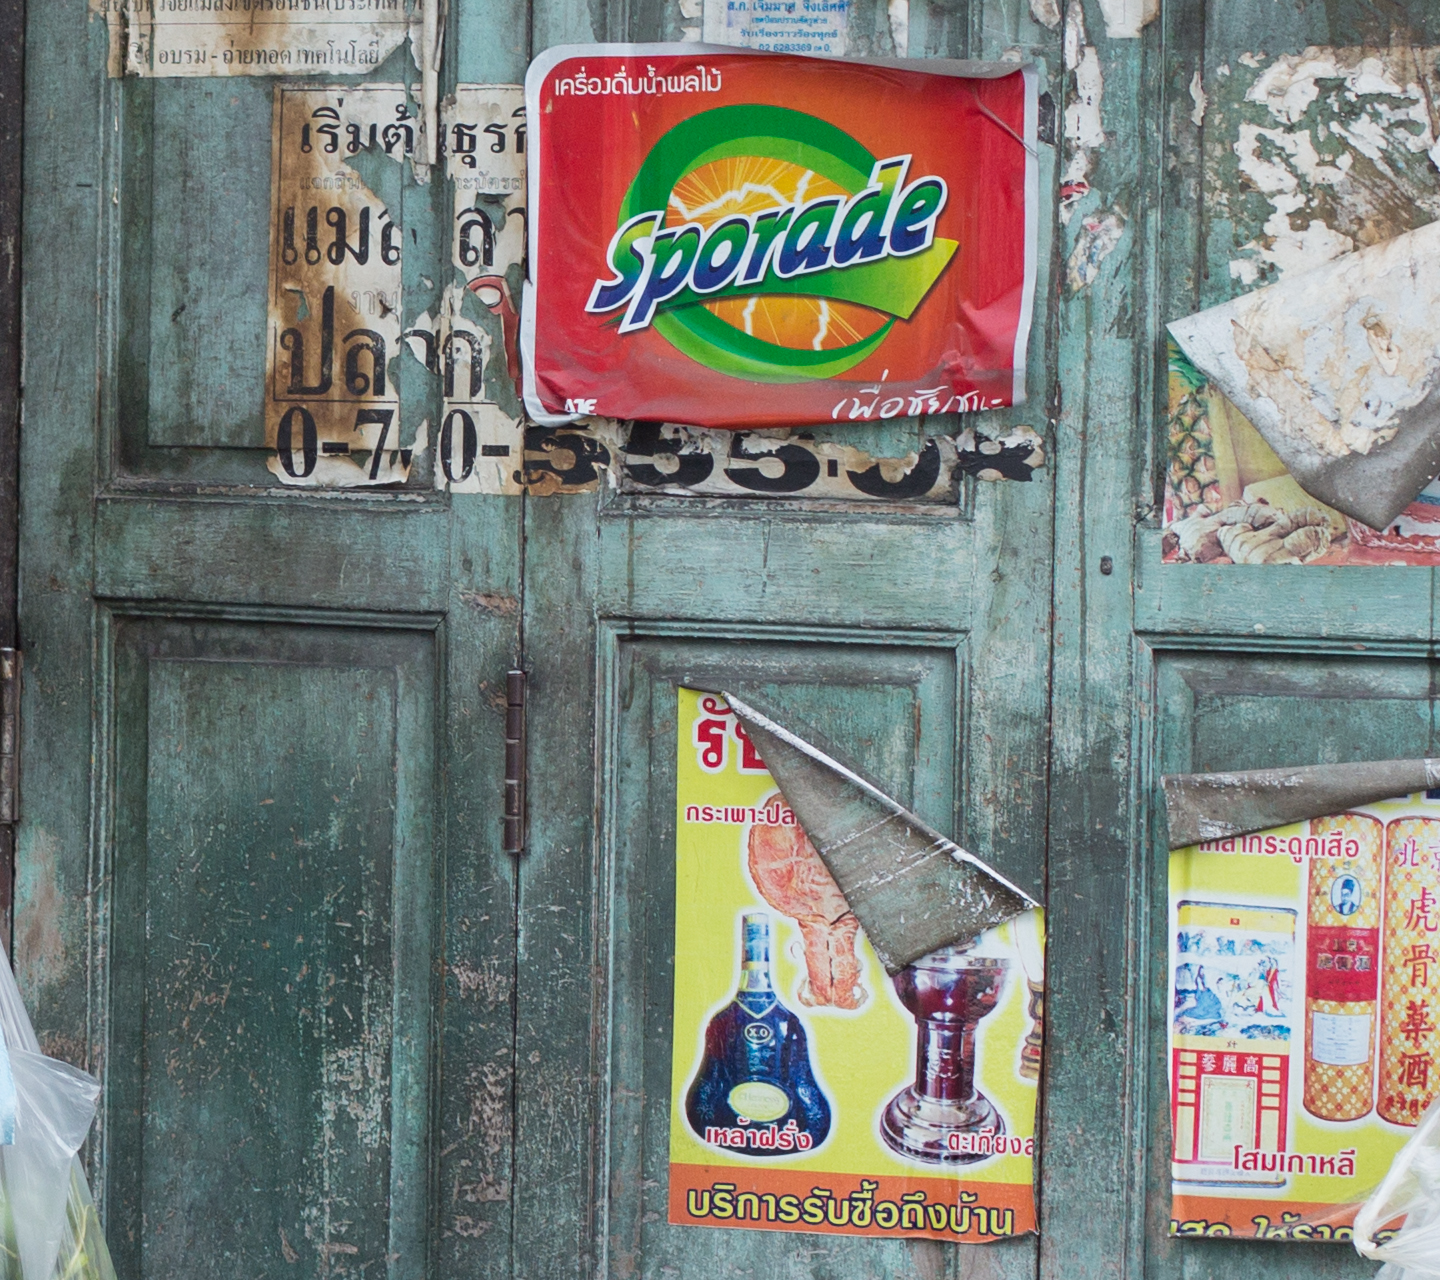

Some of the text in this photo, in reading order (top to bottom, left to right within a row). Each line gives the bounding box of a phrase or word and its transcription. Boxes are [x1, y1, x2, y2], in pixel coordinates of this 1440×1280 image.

[554, 63, 722, 98] เครื่องดื่มน้ำผลไม้
[585, 152, 948, 334] Sporade
[706, 1117, 812, 1149] เหล้าฝรั่ง
[1233, 1144, 1356, 1176] โสมเกาหลี
[687, 1180, 1014, 1237] บริการรับซื้อถึงบ้าน
